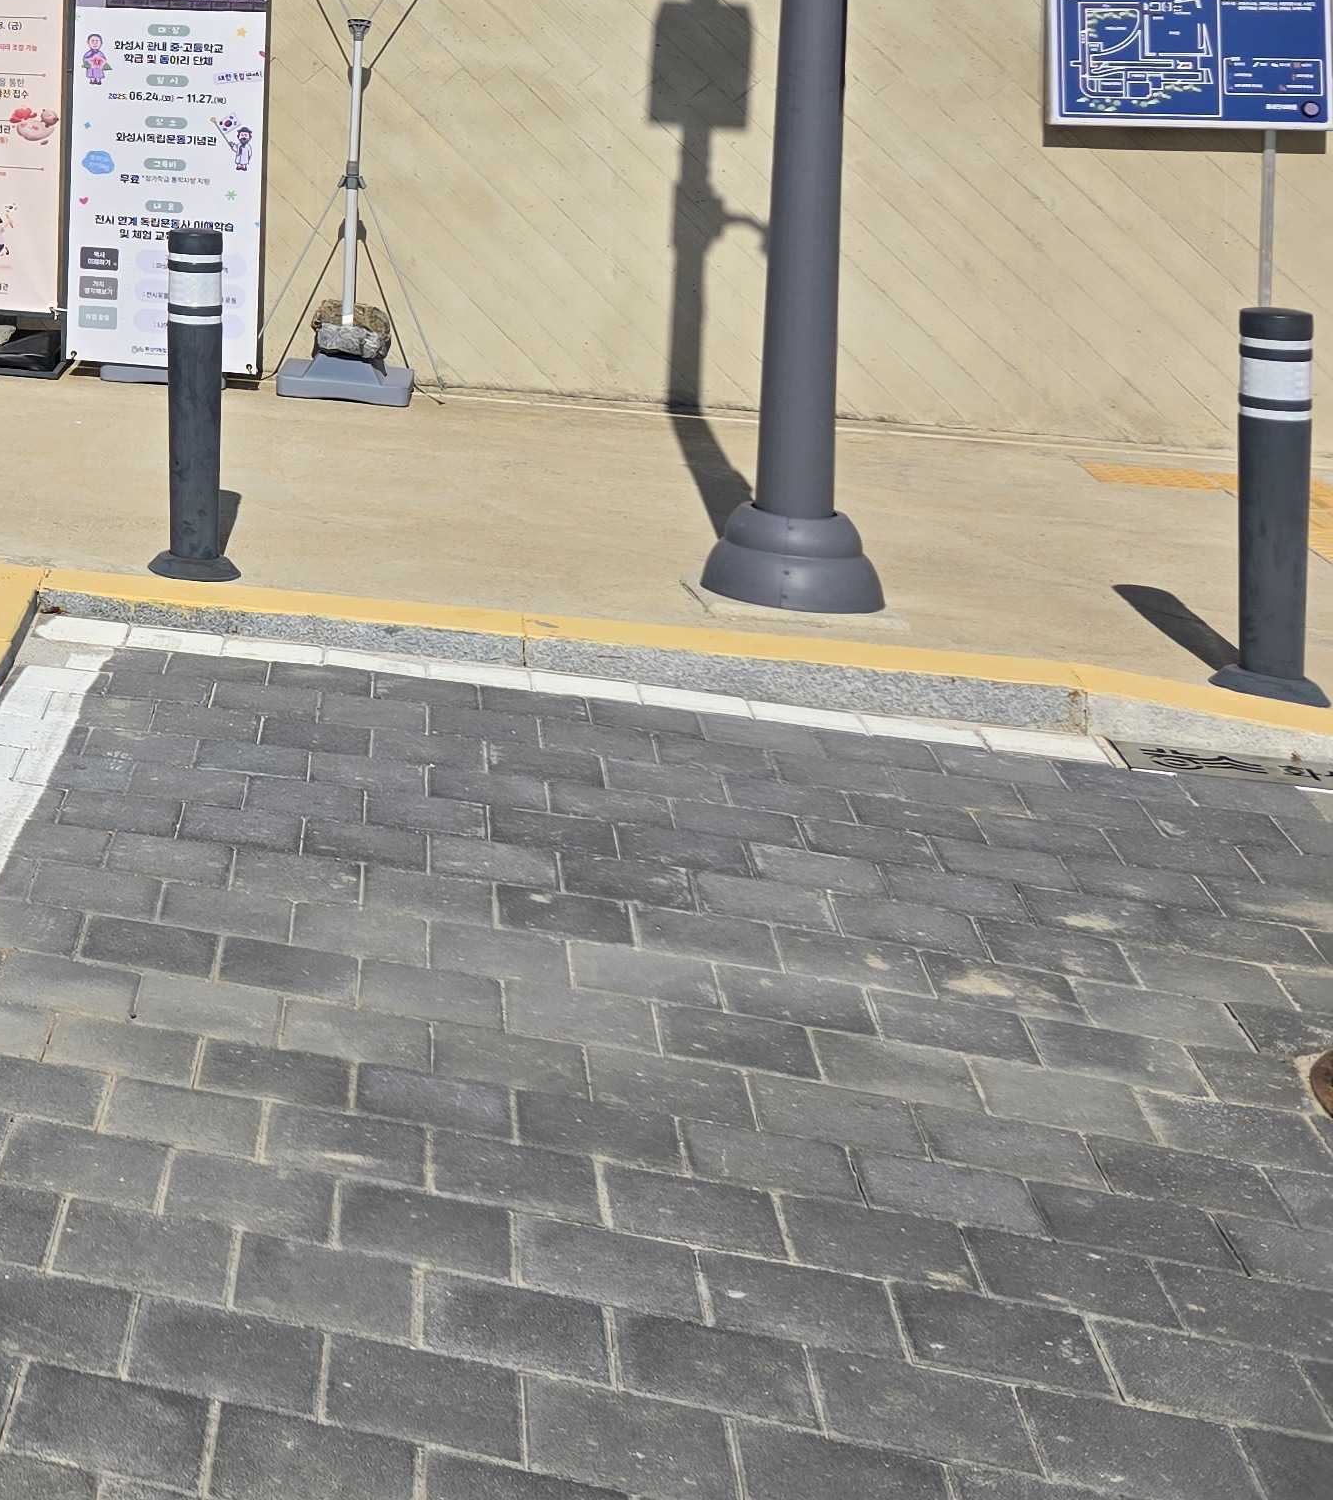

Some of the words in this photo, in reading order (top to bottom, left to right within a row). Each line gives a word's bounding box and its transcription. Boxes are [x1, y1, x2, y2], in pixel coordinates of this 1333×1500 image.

[114, 41, 144, 51] 화성시
[147, 42, 167, 51] 관내
[124, 53, 143, 63] 학급
[147, 54, 156, 64] 및
[160, 55, 189, 65] 동아리
[193, 56, 212, 66] 단체
[116, 132, 216, 146] 화성시독립운동기념관
[120, 174, 139, 184] 무료
[94, 215, 114, 225] 전시
[118, 215, 137, 226] 연계
[140, 217, 190, 229] 독립운동사
[119, 229, 129, 239] 및
[132, 230, 151, 240] 체험
